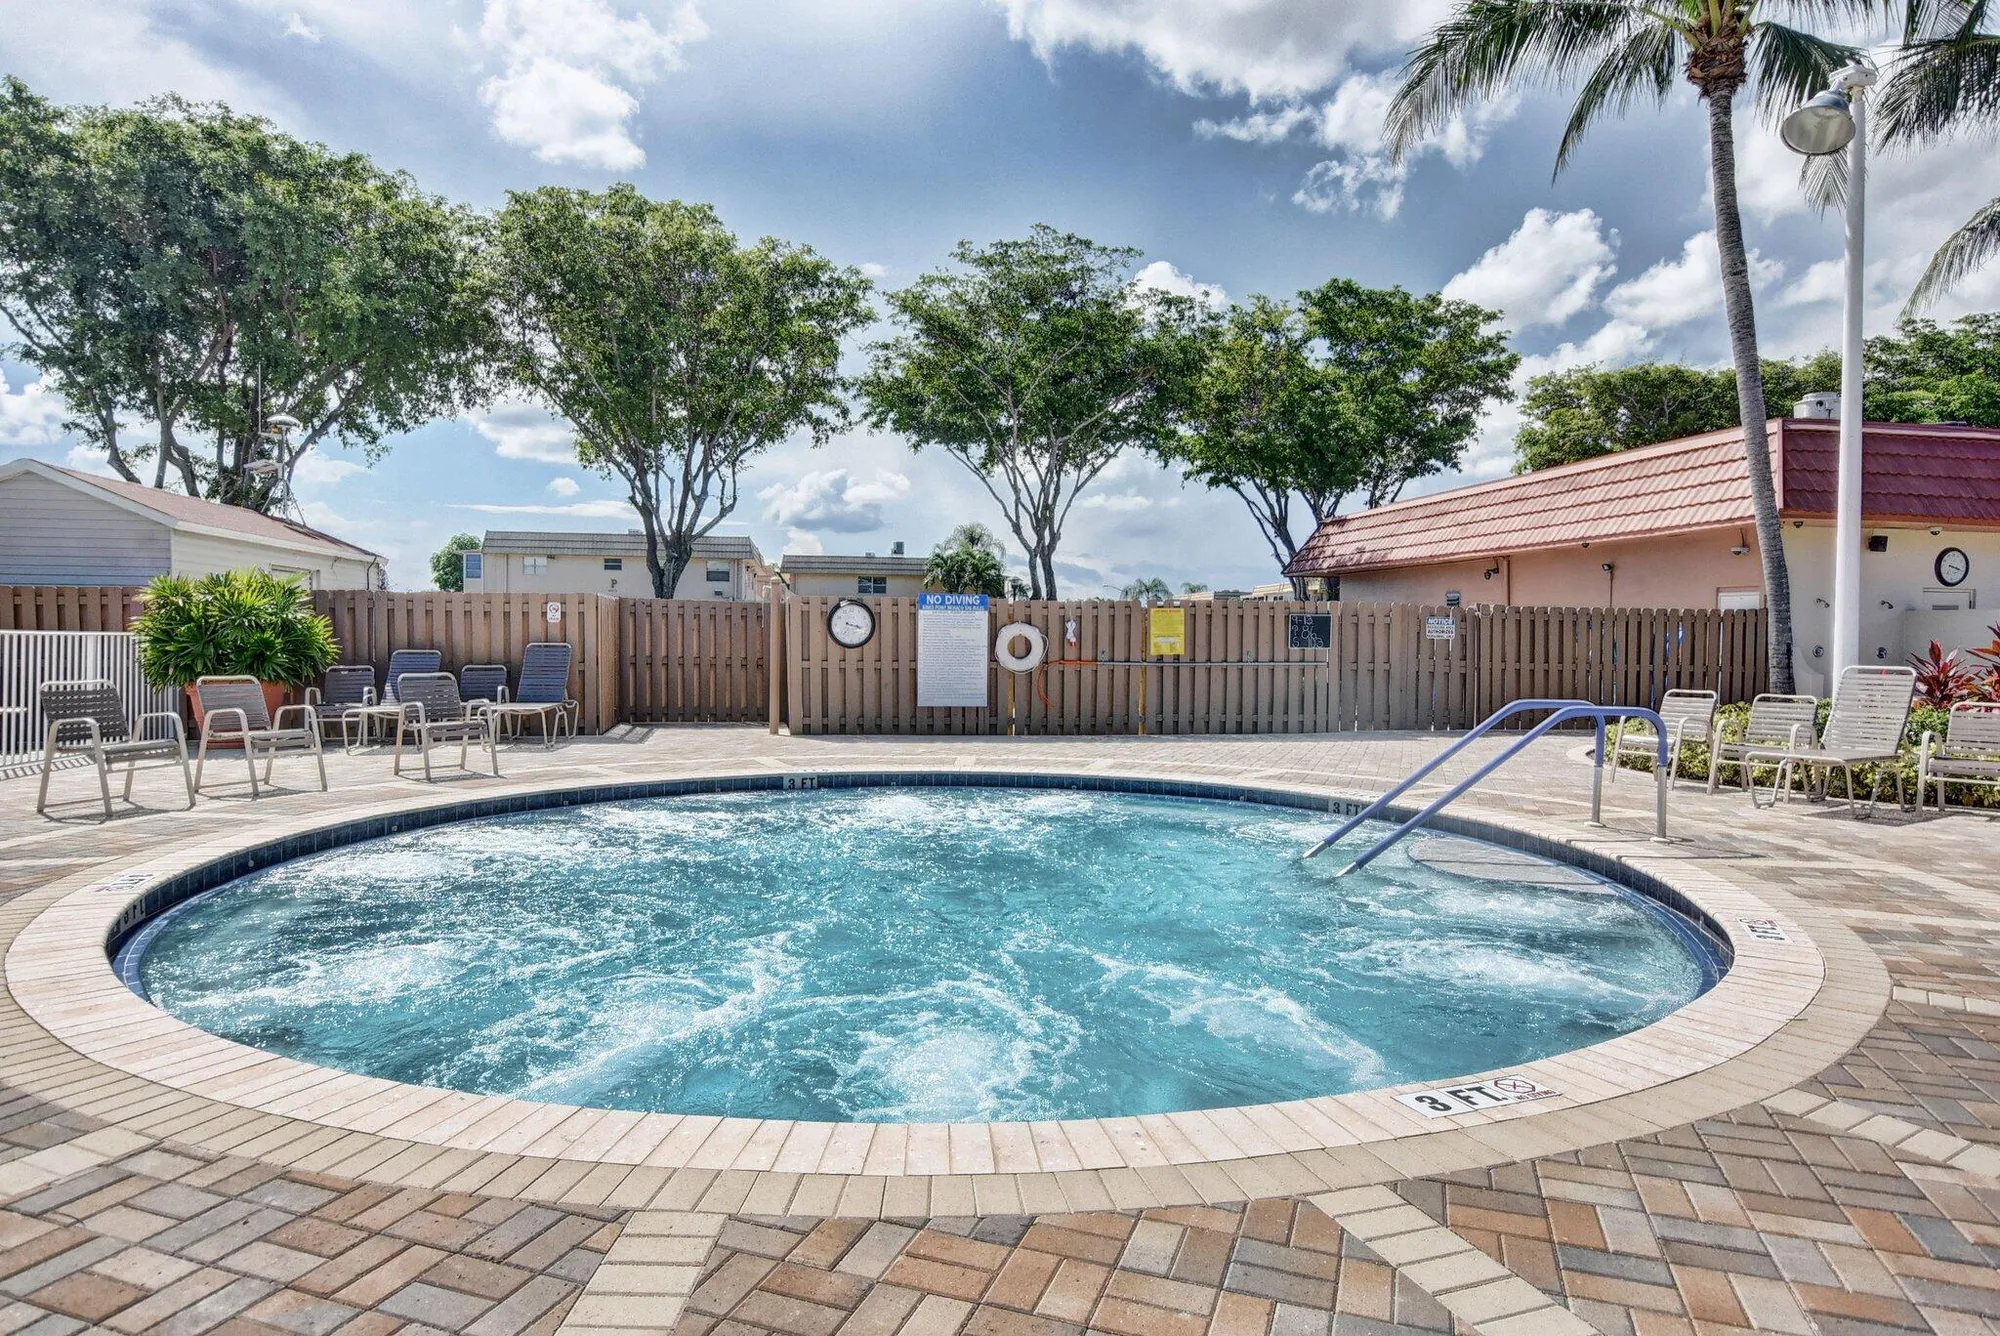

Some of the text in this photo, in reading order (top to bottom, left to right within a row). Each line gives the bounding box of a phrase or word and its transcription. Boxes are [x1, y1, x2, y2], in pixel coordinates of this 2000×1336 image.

[926, 595, 981, 605] NO DIVING
[788, 777, 815, 790] 3 FT
[1333, 802, 1360, 816] 3 FT
[1414, 1086, 1509, 1112] 3 FT.
